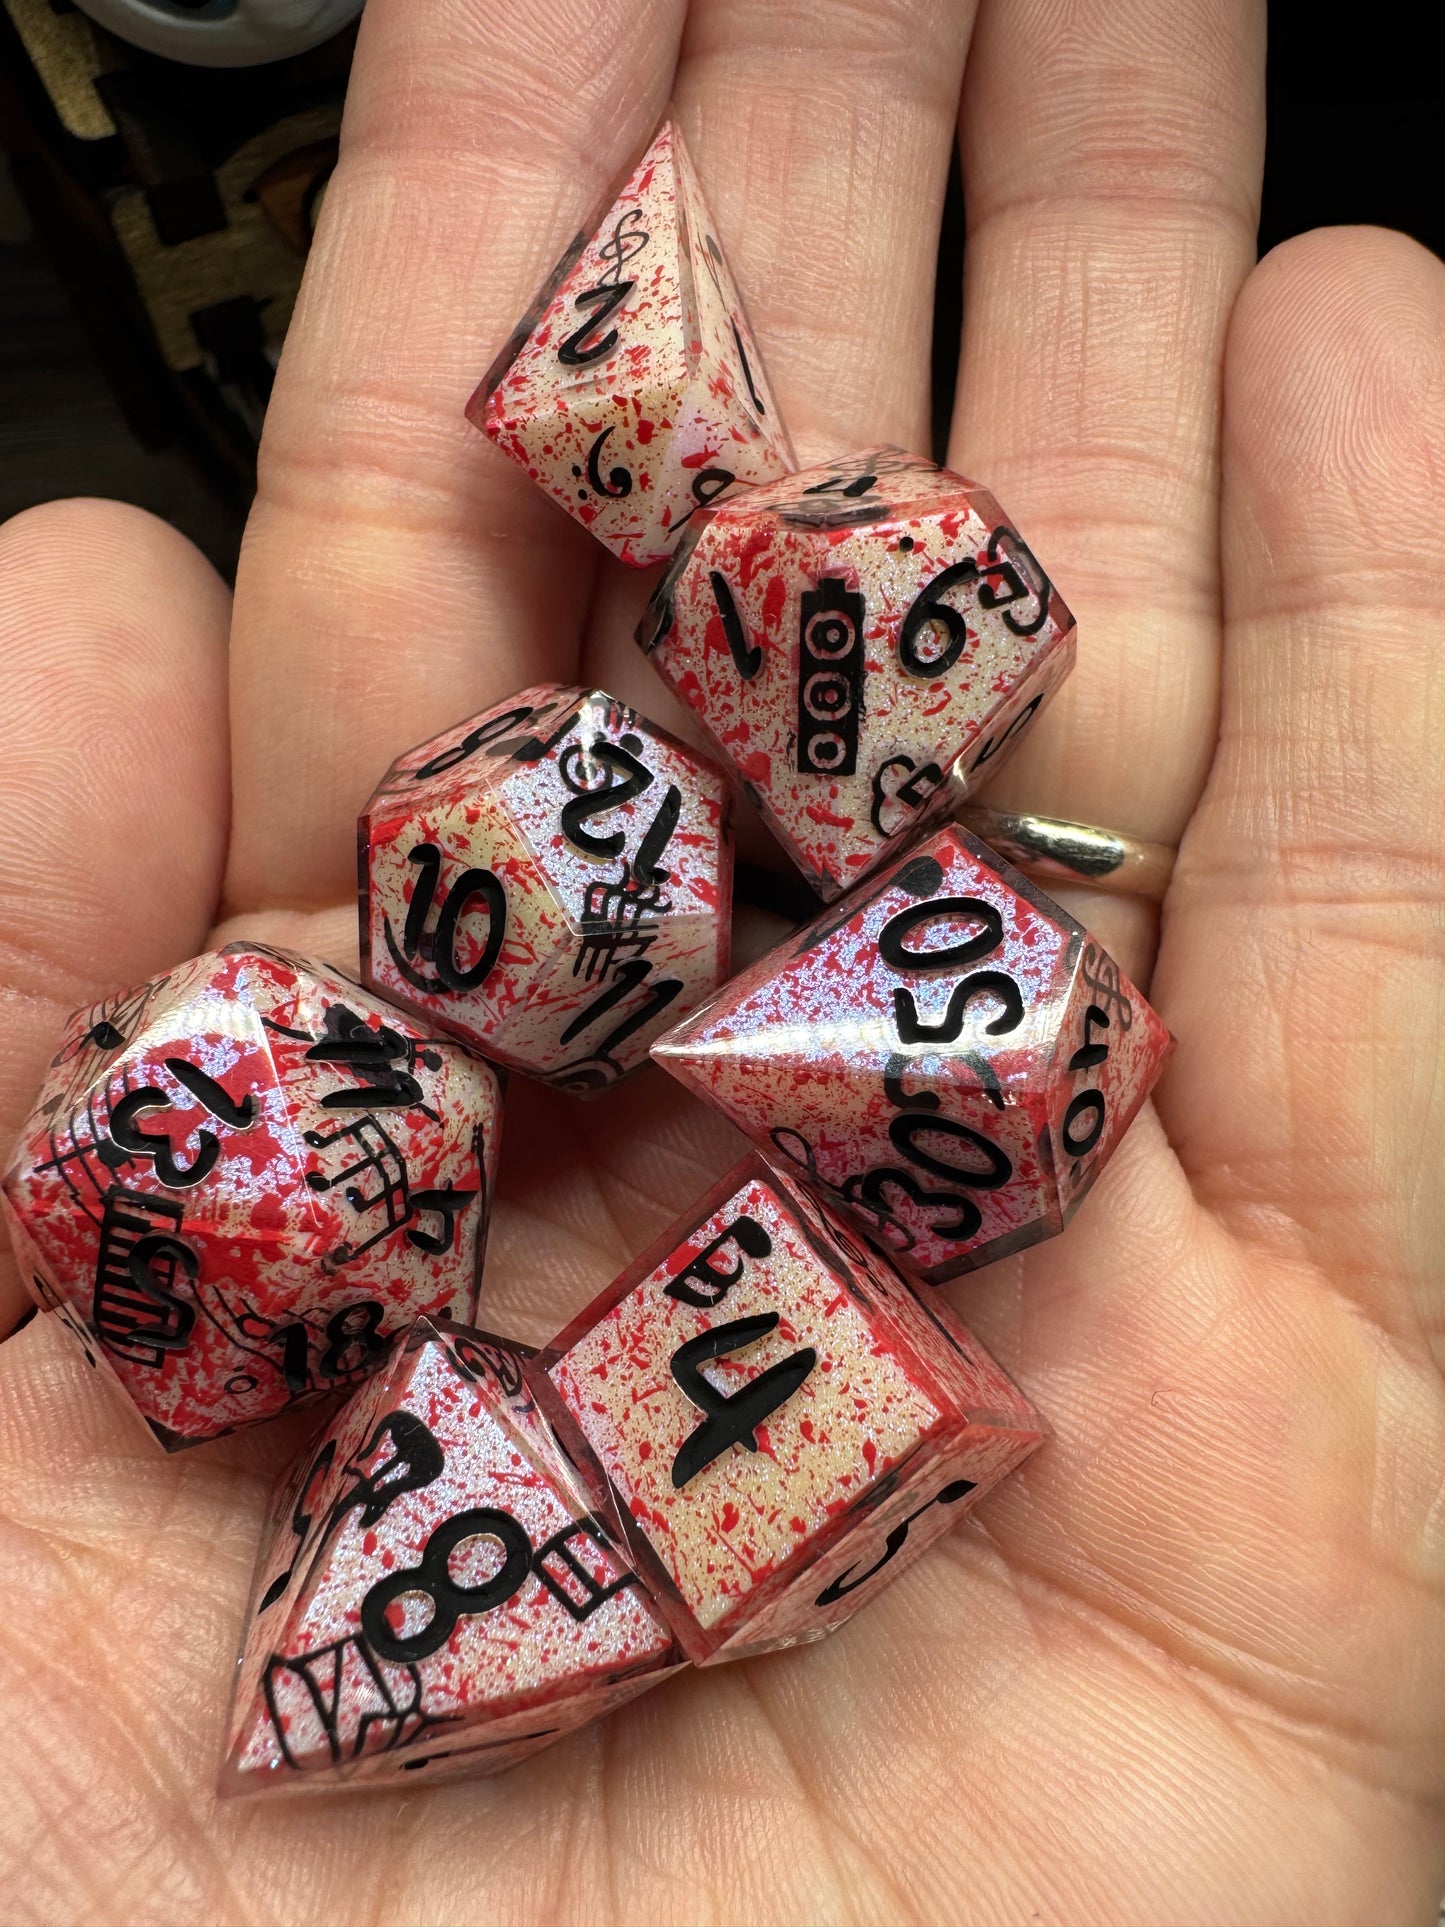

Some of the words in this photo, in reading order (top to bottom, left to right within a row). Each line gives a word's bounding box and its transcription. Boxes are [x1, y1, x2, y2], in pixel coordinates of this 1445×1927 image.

[558, 281, 636, 365] 2
[709, 571, 763, 680] 1
[404, 843, 507, 992] 10
[879, 896, 1024, 1045] 50
[559, 959, 685, 1060] 11
[860, 1113, 1013, 1241] 30
[270, 1301, 386, 1390] 18
[670, 1311, 817, 1490] 4
[361, 1507, 533, 1664] 8
